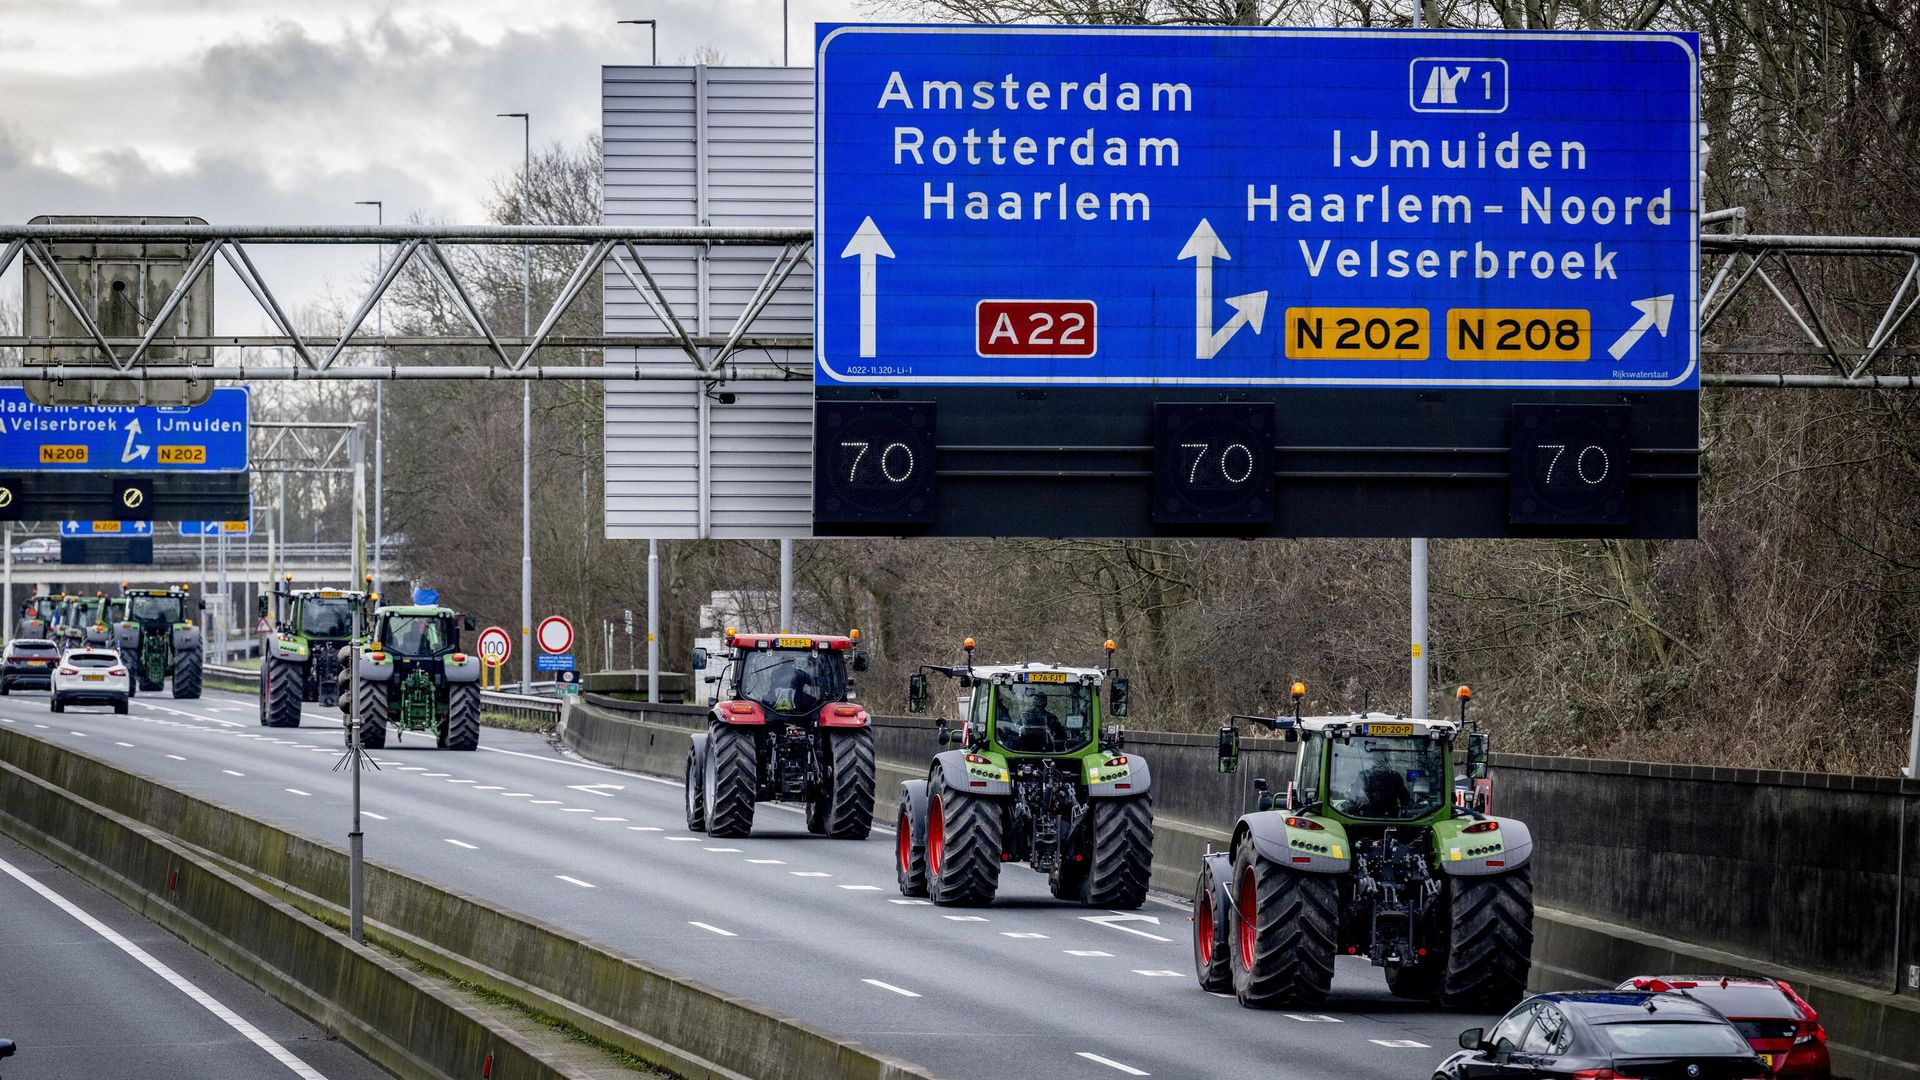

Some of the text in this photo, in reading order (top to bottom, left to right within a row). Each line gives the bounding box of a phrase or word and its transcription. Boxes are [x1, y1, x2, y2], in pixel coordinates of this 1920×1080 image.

[877, 71, 1192, 112] Amsterdam
[1481, 71, 1491, 100] 1
[894, 126, 1180, 167] Rotterdam
[1333, 129, 1586, 170] IJmuiden
[923, 182, 1151, 221] Haarlem
[1298, 239, 1618, 280] Velserbroek
[1612, 370, 1668, 379] Rijkswaterstaat
[11, 417, 117, 431] Velserbroek
[157, 418, 242, 432] IJmuiden
[841, 442, 914, 482] 70
[1181, 443, 1253, 483] 70
[1537, 445, 1609, 484] 70
[484, 641, 505, 656] 100
[1033, 674, 1064, 682] T-76-FJT
[1371, 725, 1410, 734] TPD-20-P
